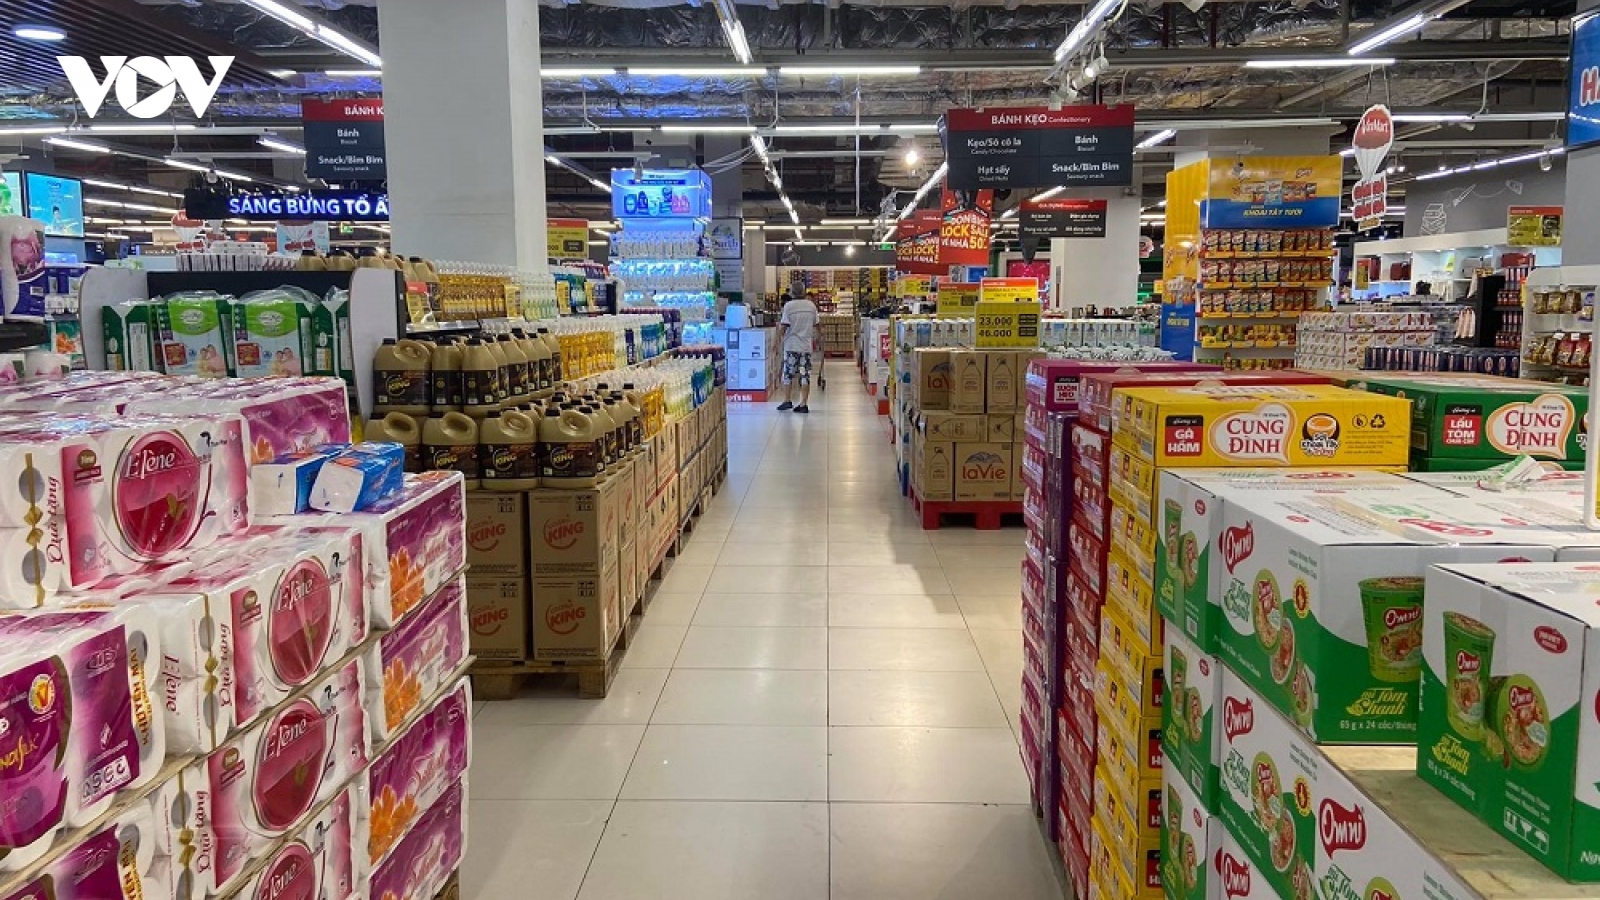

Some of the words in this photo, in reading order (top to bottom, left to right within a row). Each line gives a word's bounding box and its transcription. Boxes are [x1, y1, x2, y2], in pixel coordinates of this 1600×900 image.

[344, 104, 375, 115] BÁNH
[991, 113, 1022, 124] BÁNH
[1024, 113, 1047, 126] KẸO
[337, 128, 359, 137] Bánh
[1074, 134, 1099, 144] Bánh
[366, 155, 384, 164] Bim
[1101, 161, 1119, 171] Bim
[229, 195, 282, 214] SÁNG
[285, 193, 340, 214] BỪNG
[343, 194, 371, 215] TỔ
[375, 194, 389, 215] Ấ
[1226, 418, 1284, 435] CUNG
[1505, 410, 1562, 427] CUNG
[1174, 427, 1195, 440] GÀ
[1506, 426, 1557, 447] ĐÌNH
[1228, 435, 1281, 454] ĐÌNH
[962, 463, 1006, 480] laVie
[468, 520, 506, 545] KING
[548, 520, 585, 543] KING
[471, 607, 508, 629] KING
[550, 605, 586, 627] KING
[1385, 608, 1419, 626] Omni
[1321, 802, 1363, 846] Omni
